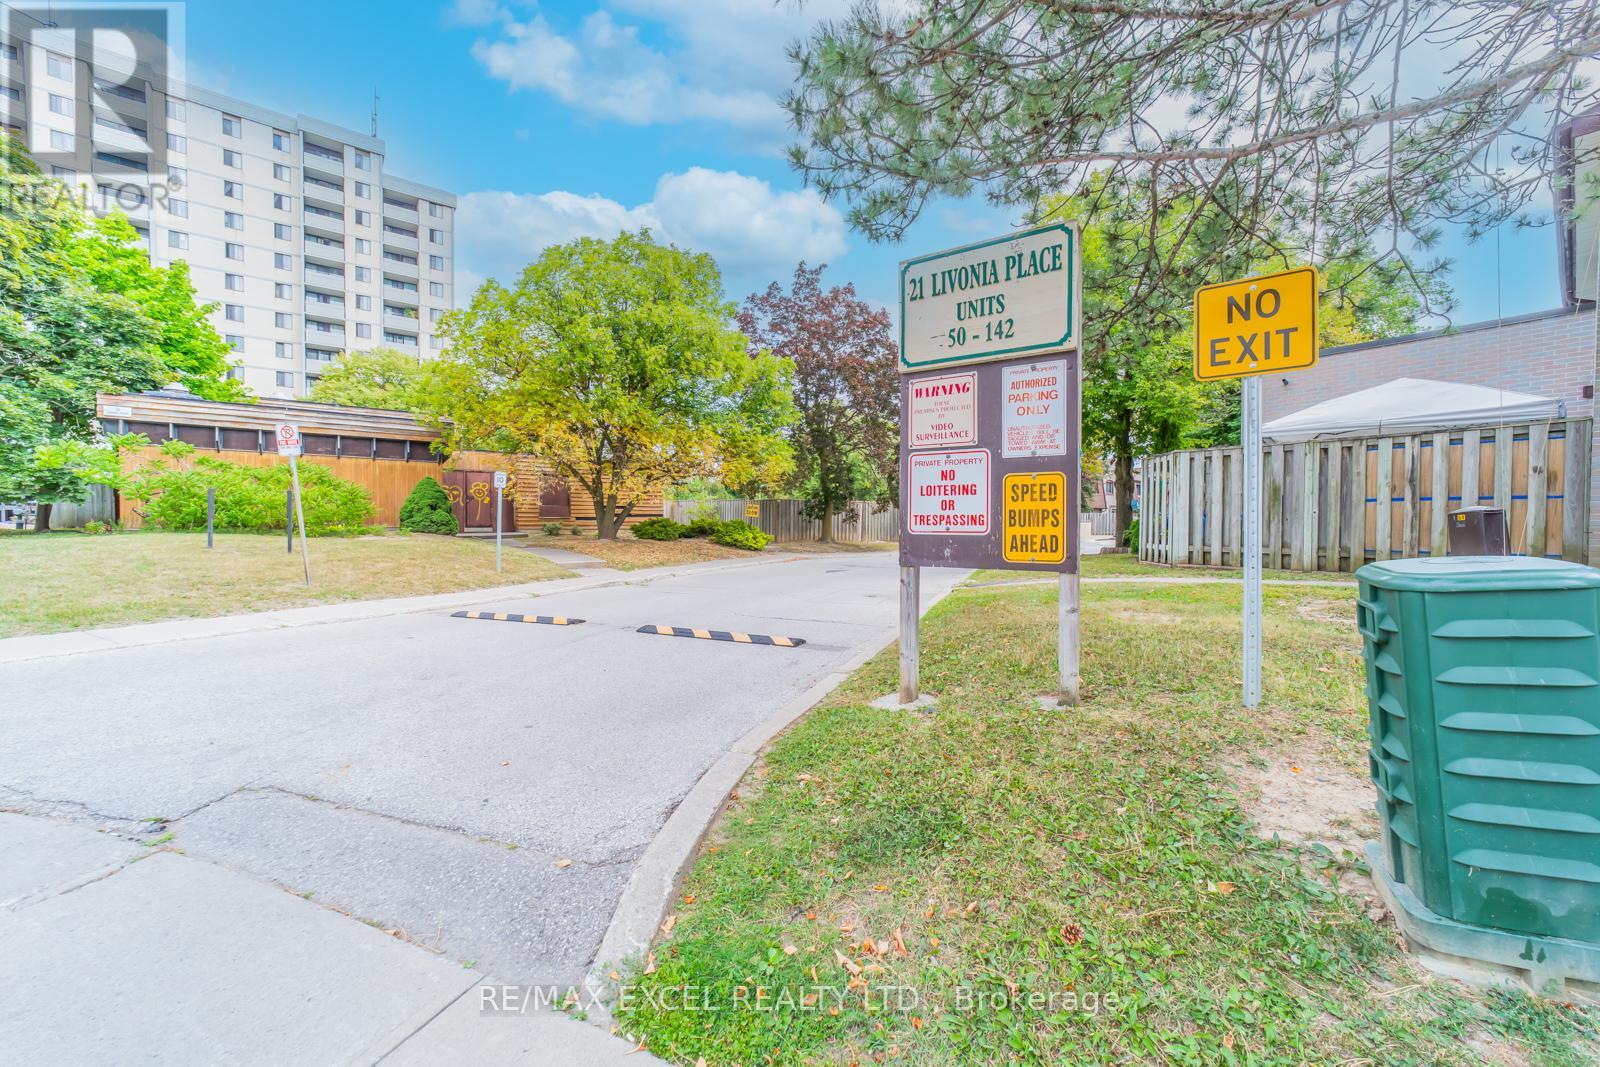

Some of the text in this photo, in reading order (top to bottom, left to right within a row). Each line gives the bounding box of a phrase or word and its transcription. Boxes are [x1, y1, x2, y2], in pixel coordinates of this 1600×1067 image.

[909, 243, 1063, 302] 21 LIVONIA PLACE
[956, 293, 1005, 321] UNITS
[1227, 288, 1281, 324] NO
[948, 326, 967, 348] 50
[985, 318, 1015, 342] 142
[1210, 327, 1299, 367] EXIT
[915, 382, 971, 399] WARNING
[1010, 376, 1057, 390] AUTHORIZED
[1008, 389, 1058, 404] PARKING
[1016, 404, 1050, 416] ONLY
[931, 422, 954, 431] VIDEO
[915, 430, 969, 441] SURVEILLANCE
[914, 457, 984, 467] PRIVATE PROPERTY
[940, 469, 956, 481] NO
[920, 483, 977, 497] LOITERING
[1010, 483, 1057, 502] SPEED
[940, 499, 955, 511] OR
[913, 514, 985, 526] TRESPASSING
[1008, 508, 1060, 528] BUMPS
[1009, 534, 1059, 553] AHEAD
